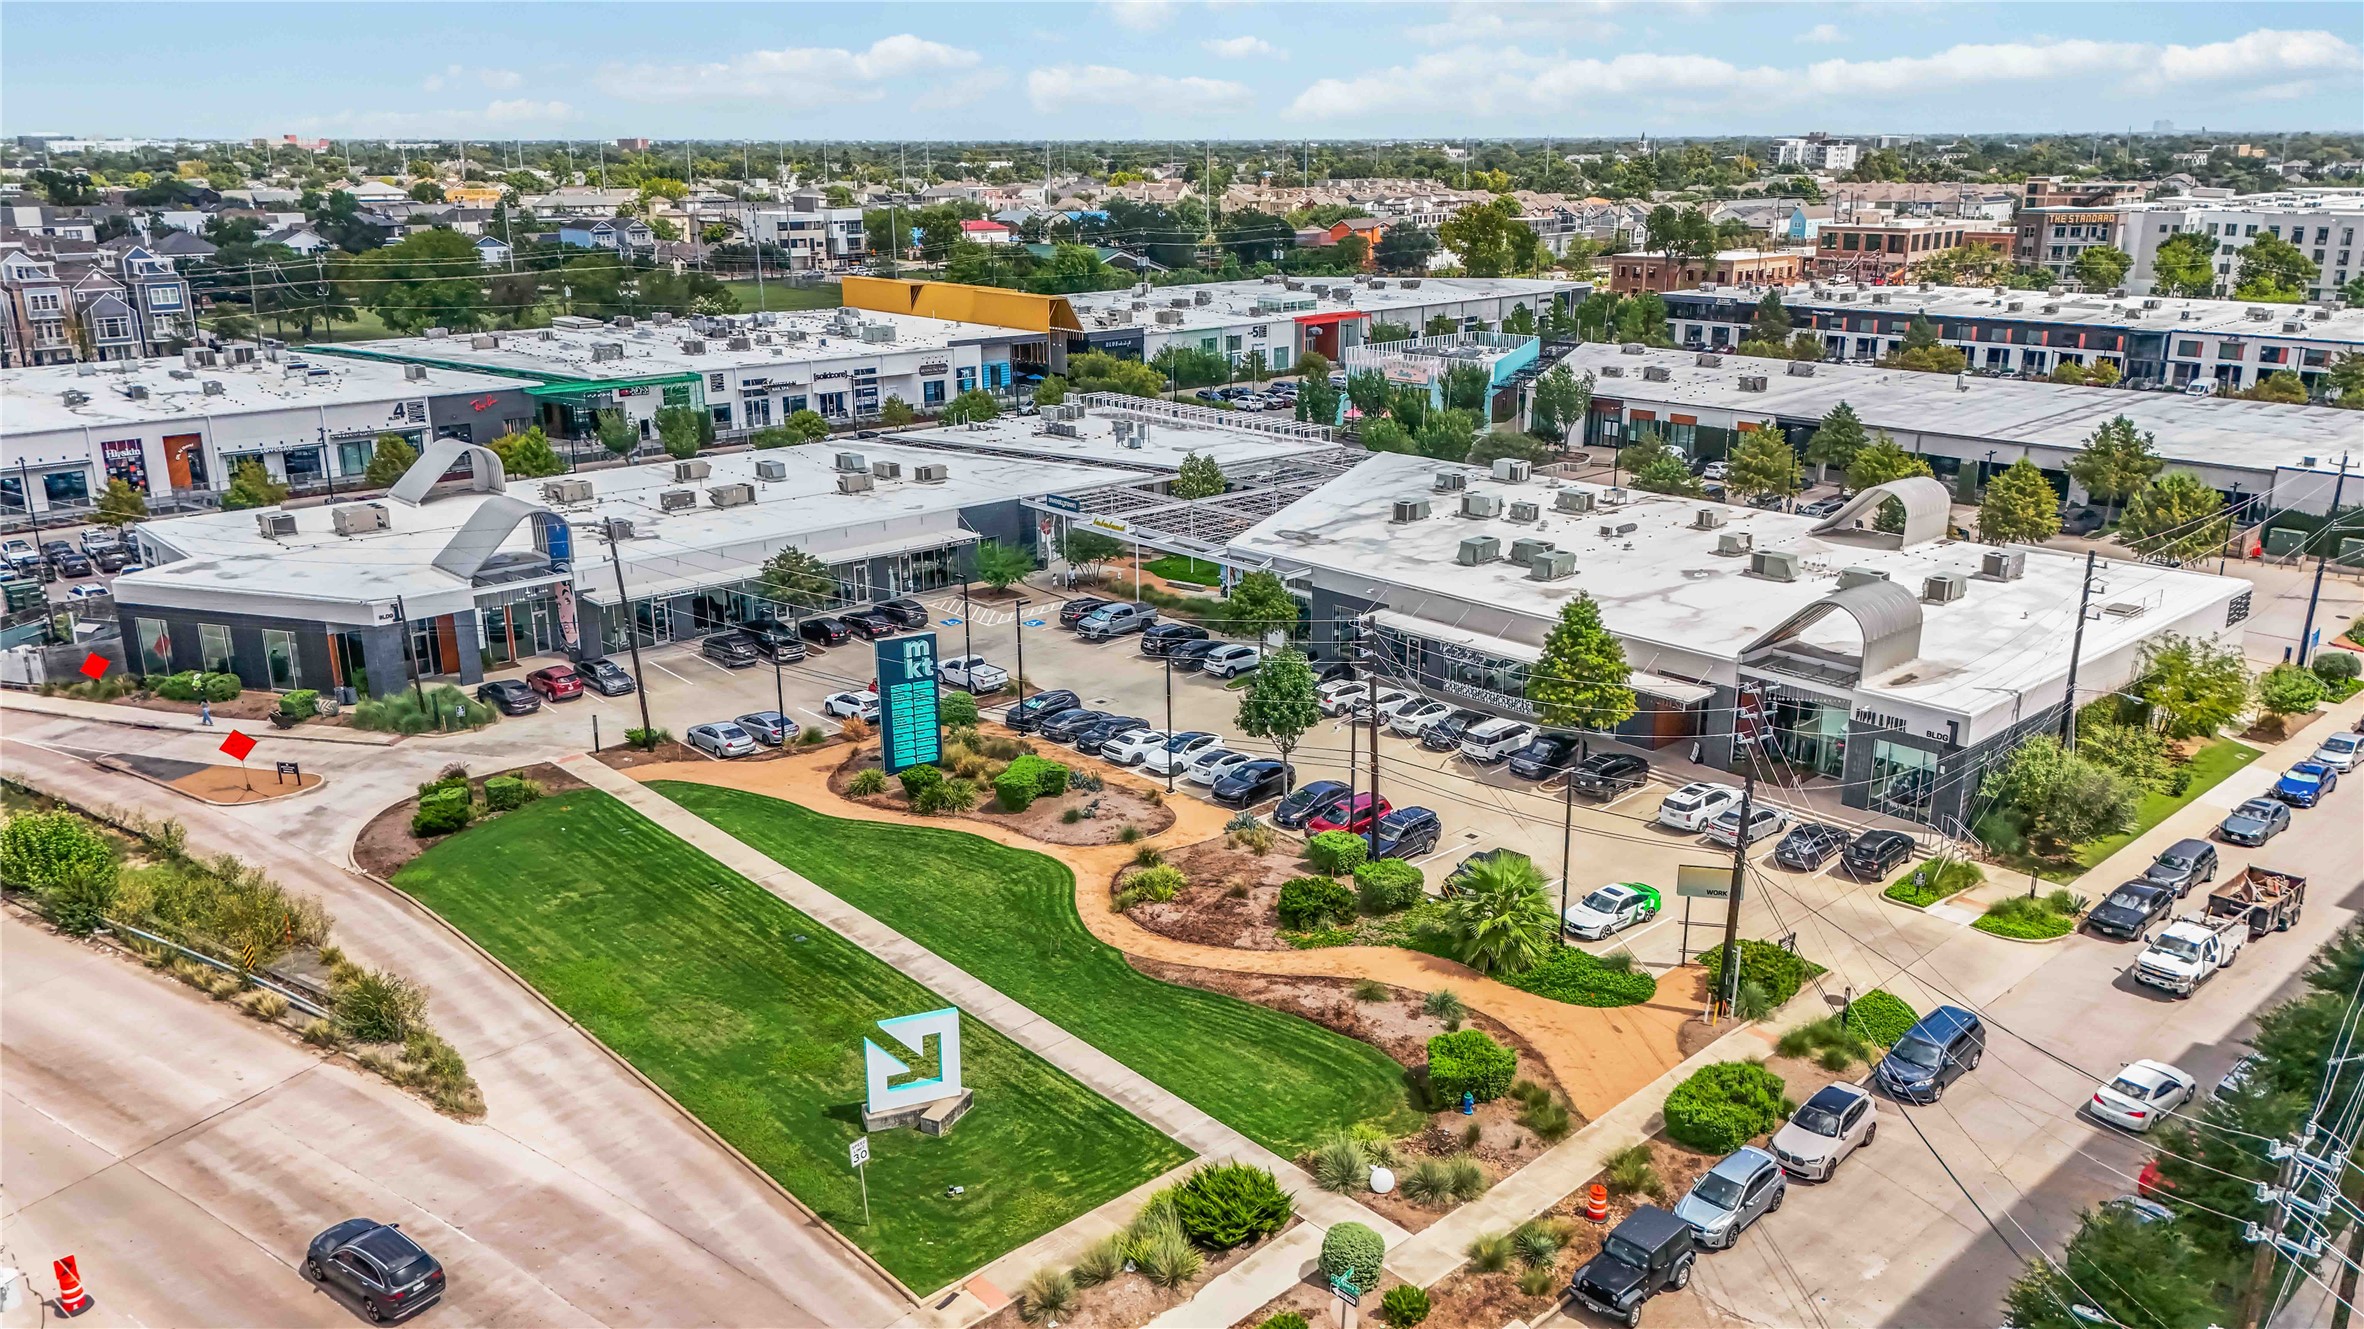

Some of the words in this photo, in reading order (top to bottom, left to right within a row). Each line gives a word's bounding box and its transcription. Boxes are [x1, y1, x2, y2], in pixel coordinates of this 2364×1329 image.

[2049, 214, 2067, 223] THE
[2068, 214, 2115, 223] STANDARD
[393, 402, 406, 418] 4
[390, 603, 402, 622] 1
[903, 639, 930, 658] m
[904, 656, 934, 679] kt
[1926, 730, 1949, 742] BLDG
[1706, 889, 1728, 897] WORK
[852, 1140, 866, 1150] SPEED
[853, 1150, 867, 1163] 30
